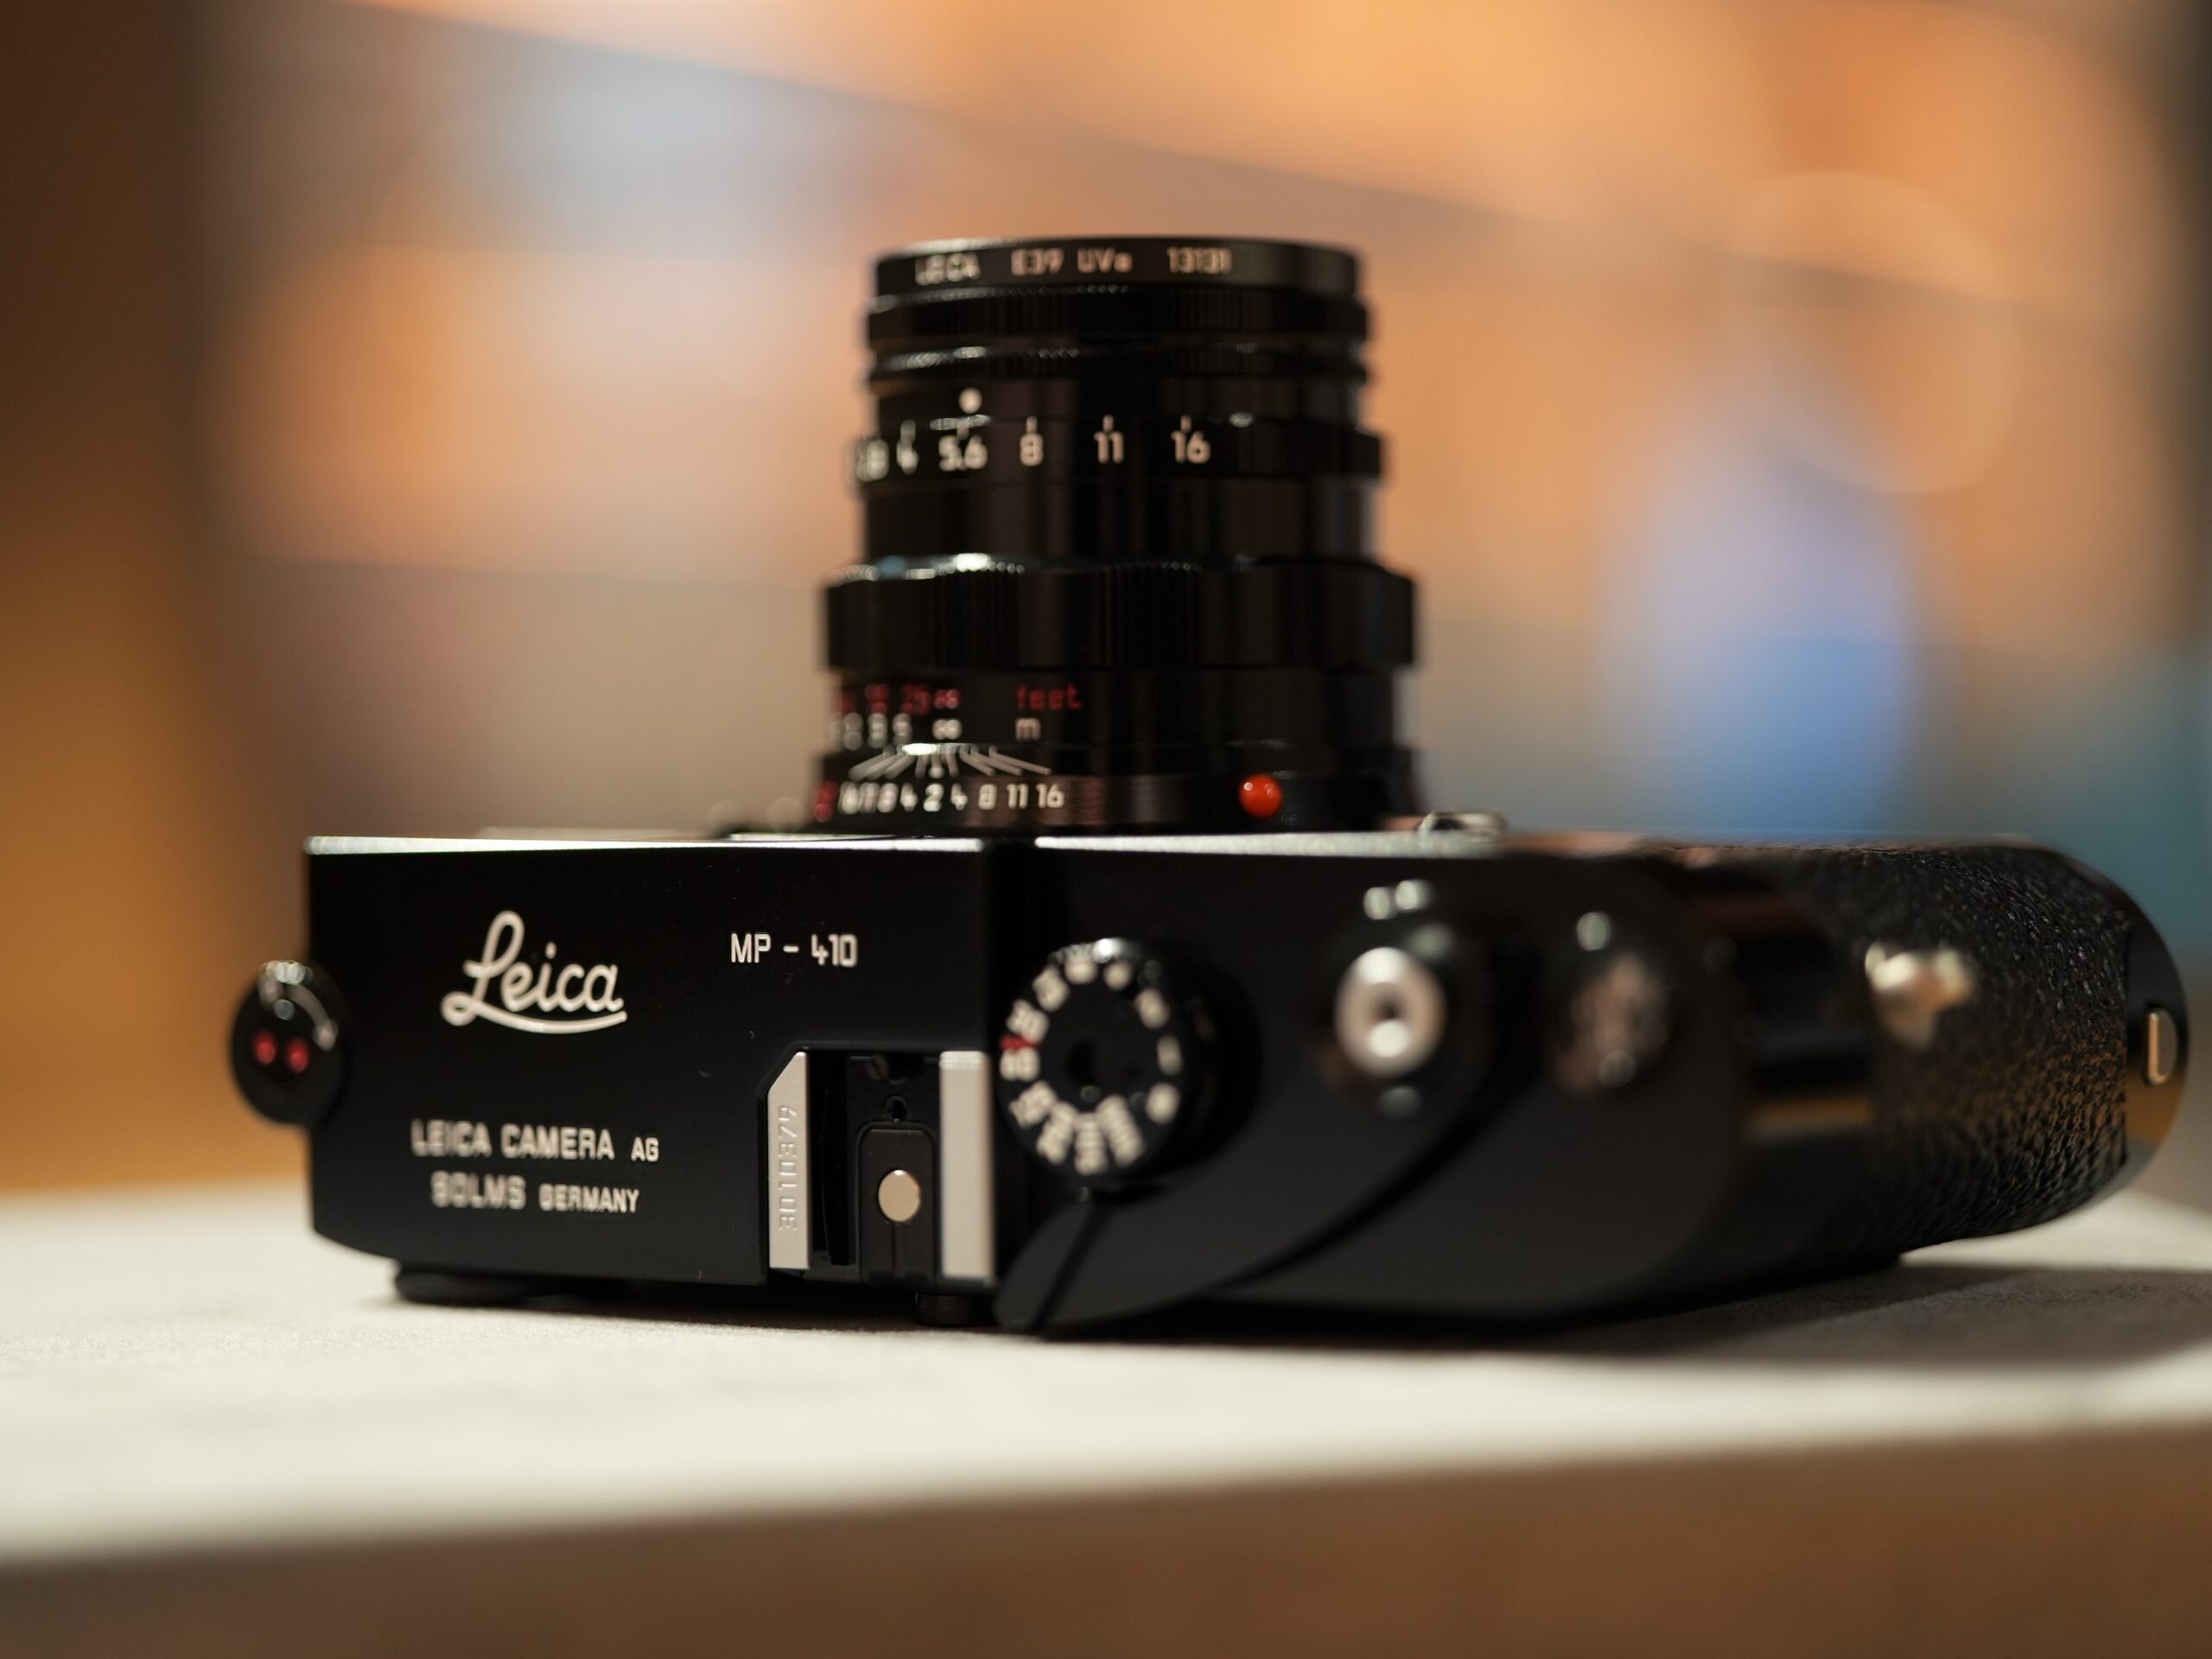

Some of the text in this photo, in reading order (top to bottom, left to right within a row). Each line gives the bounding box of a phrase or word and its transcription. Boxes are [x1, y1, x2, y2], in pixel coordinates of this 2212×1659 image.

[1020, 432, 1044, 466] 8
[1095, 430, 1123, 463] 11
[1172, 430, 1210, 463] 16
[1016, 683, 1083, 710] feet
[1015, 718, 1041, 741] m
[923, 783, 944, 812] 2
[978, 784, 997, 810] 8
[1007, 784, 1028, 809] 11
[1036, 784, 1065, 808] 16
[730, 932, 771, 964] MP
[810, 933, 858, 968] 410
[441, 910, 628, 1034] Leica
[410, 1118, 660, 1162] LEICA CAMERA AG
[430, 1170, 639, 1214] SOLMS GERMANY
